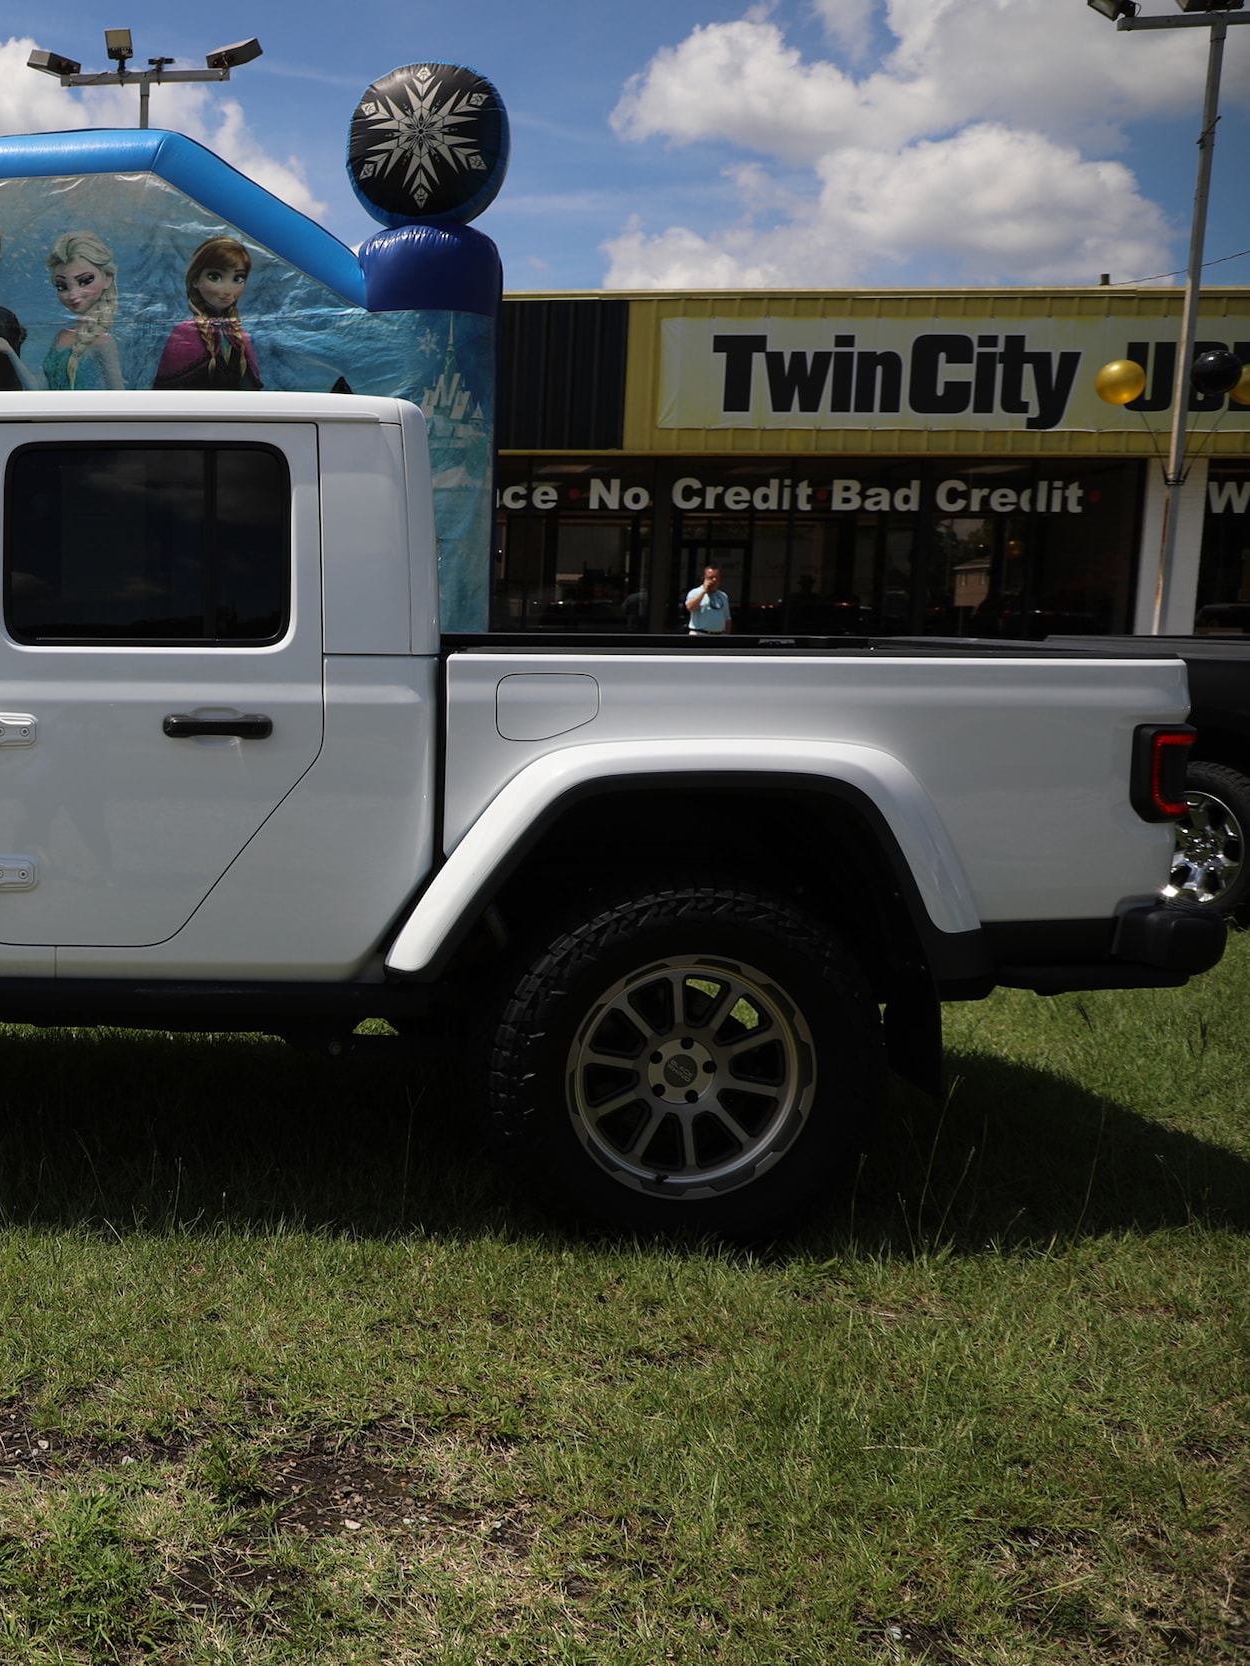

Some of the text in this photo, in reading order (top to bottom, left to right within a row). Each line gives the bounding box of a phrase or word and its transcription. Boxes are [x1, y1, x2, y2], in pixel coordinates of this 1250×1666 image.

[497, 477, 1083, 513] ce No Credit Bad Credit
[670, 1059, 693, 1077] BLACK
